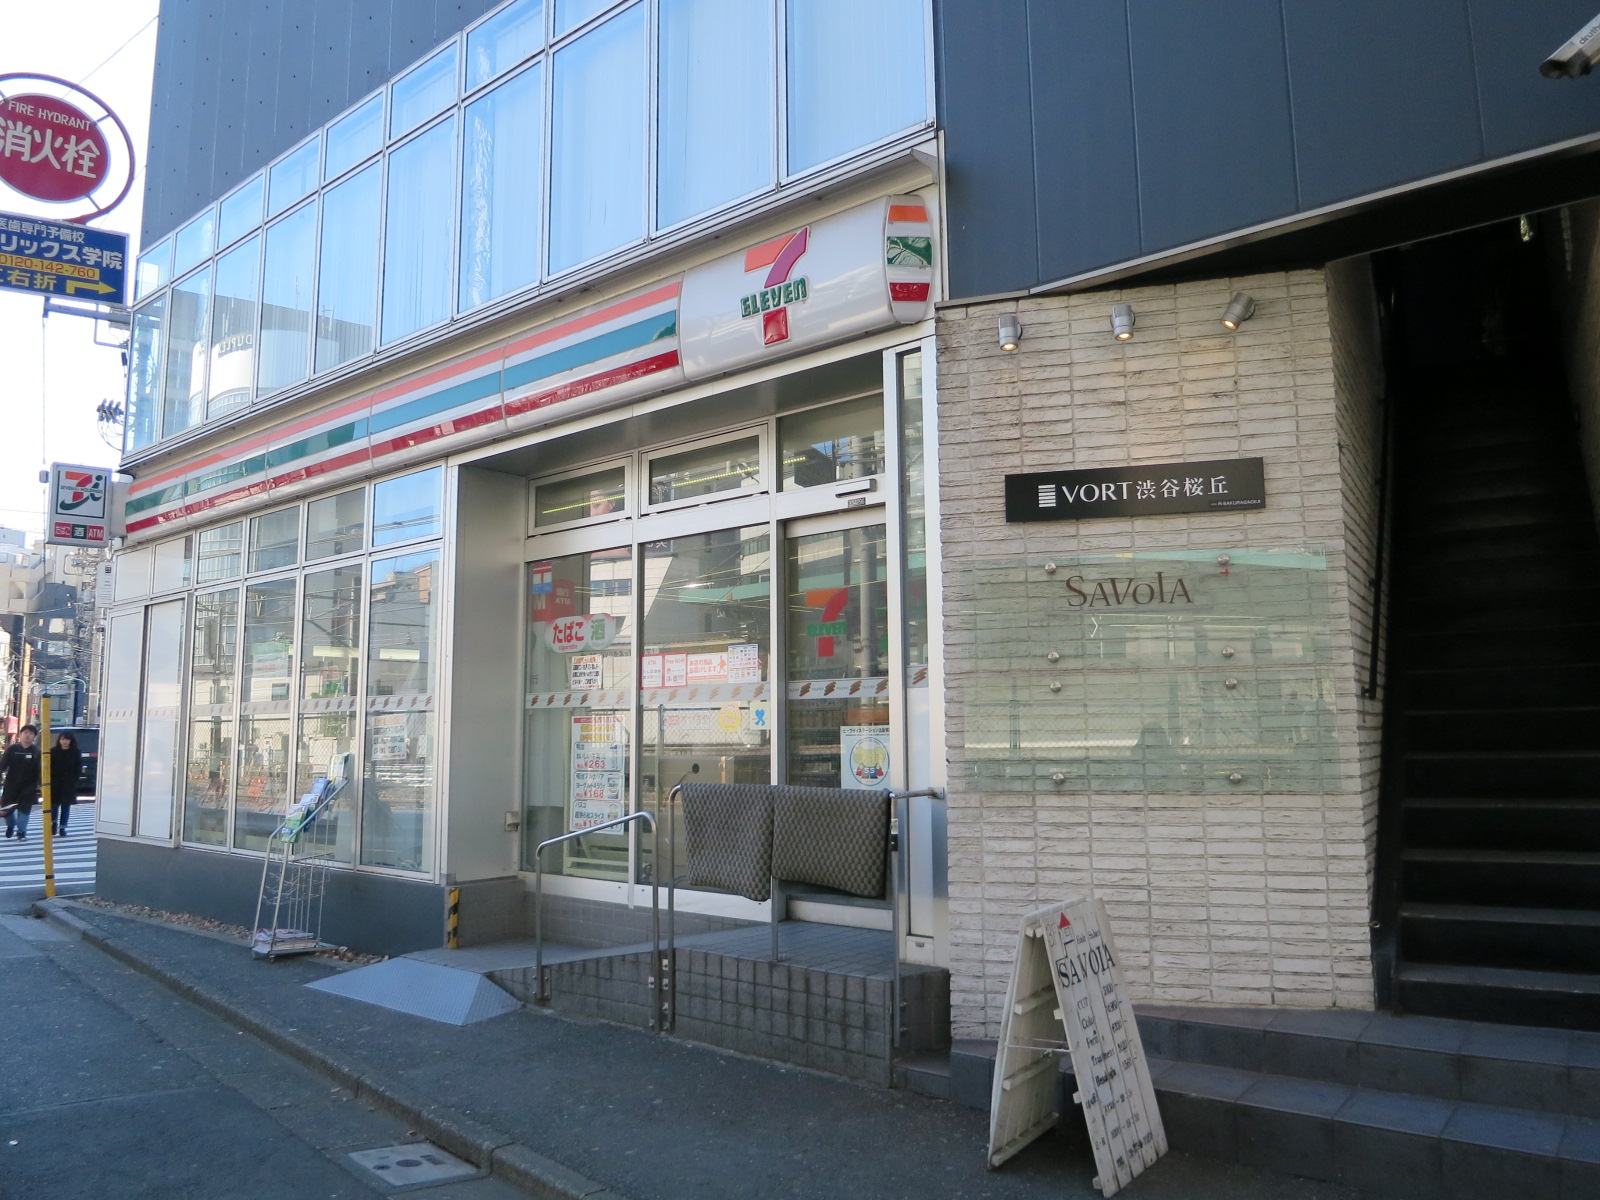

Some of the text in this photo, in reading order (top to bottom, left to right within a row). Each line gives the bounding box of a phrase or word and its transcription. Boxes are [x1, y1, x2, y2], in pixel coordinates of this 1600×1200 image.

[8, 100, 91, 132] FIRE HYDRANT
[0, 116, 100, 180] 消火栓
[0, 255, 96, 279] 0120-142-760
[1062, 481, 1132, 504] VORT
[1135, 475, 1228, 499] 渋谷桜丘
[74, 527, 85, 537] 酒
[88, 528, 104, 538] ATM
[553, 618, 606, 644] たばこ 酒
[1057, 943, 1116, 989] SAVOIA
